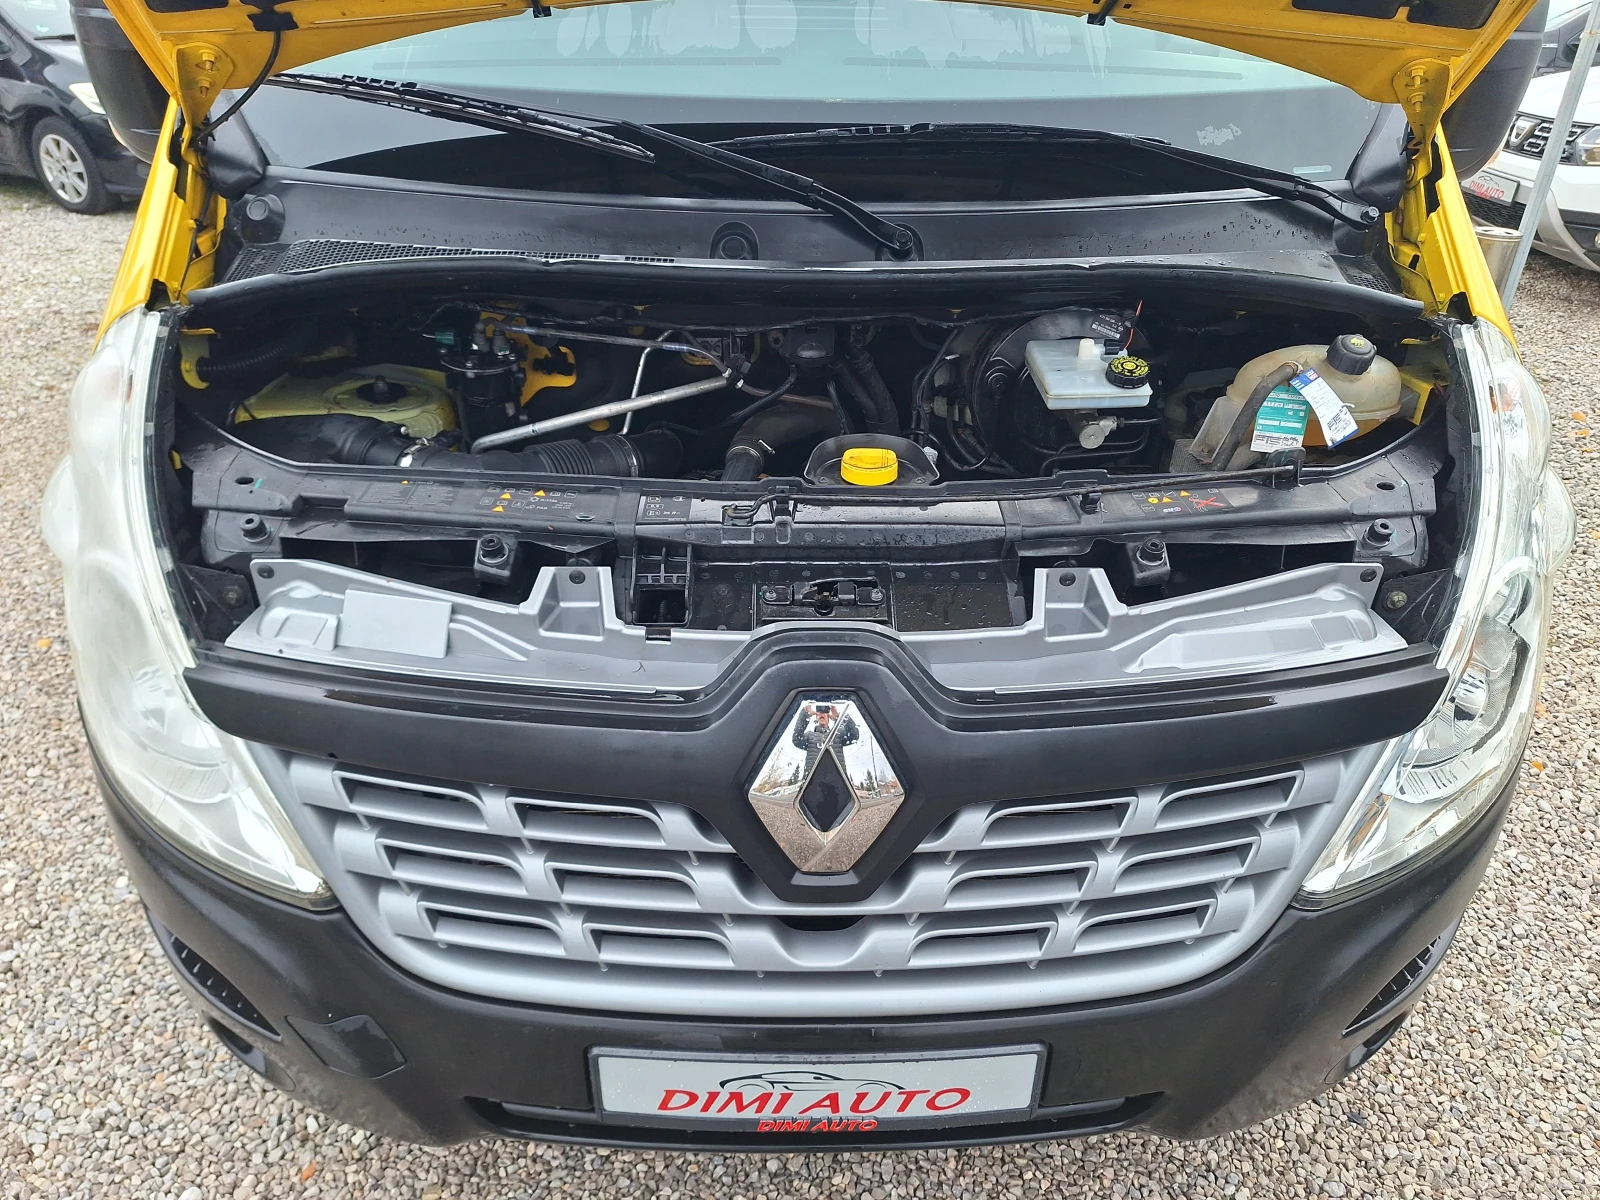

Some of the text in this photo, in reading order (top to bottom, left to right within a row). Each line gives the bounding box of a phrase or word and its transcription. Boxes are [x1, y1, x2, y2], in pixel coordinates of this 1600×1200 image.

[1469, 180, 1485, 192] DIMI
[1484, 186, 1505, 200] AUTO
[657, 1087, 971, 1115] DIMI AUTO
[756, 1119, 878, 1132] DIMI AUTO
